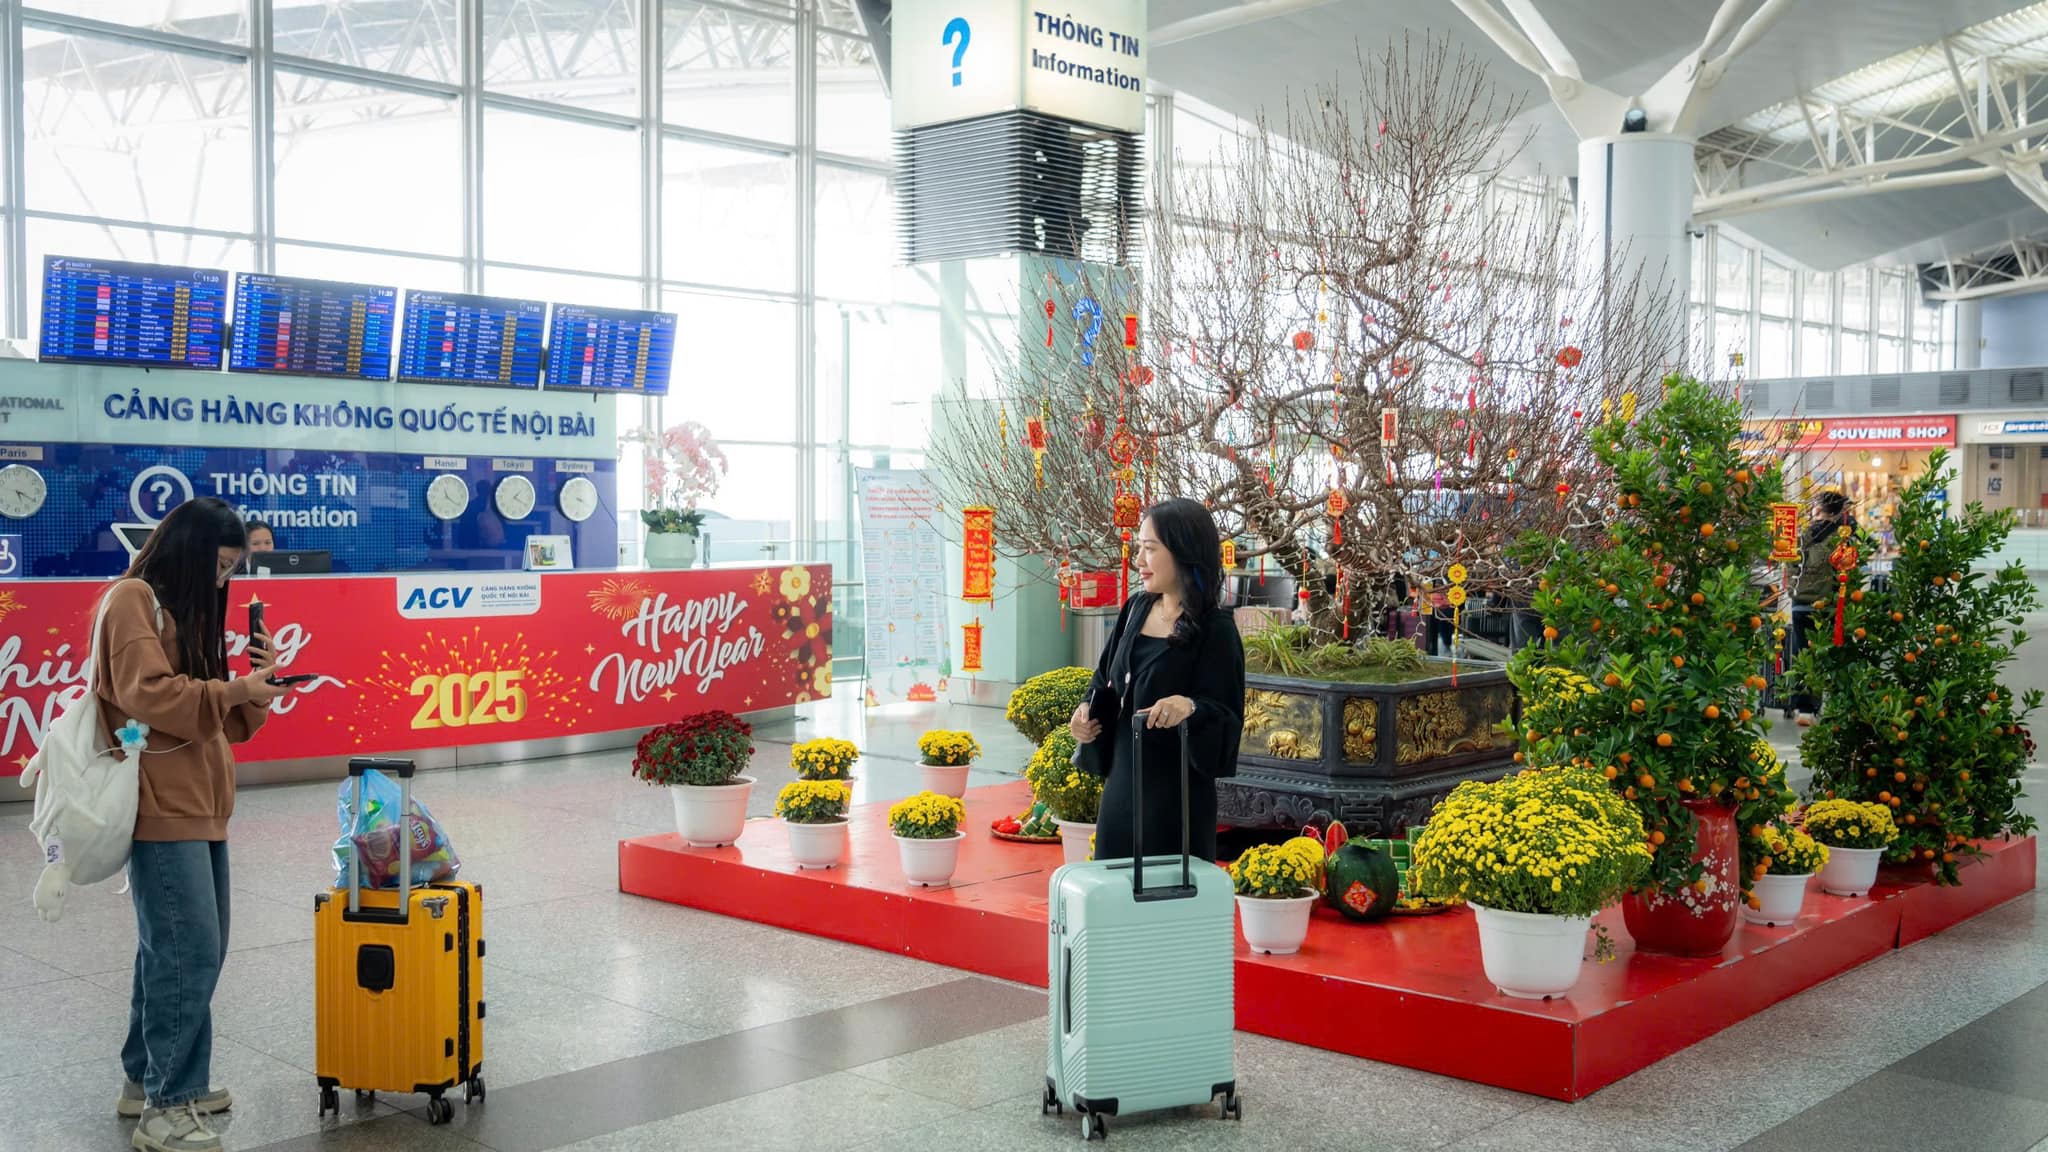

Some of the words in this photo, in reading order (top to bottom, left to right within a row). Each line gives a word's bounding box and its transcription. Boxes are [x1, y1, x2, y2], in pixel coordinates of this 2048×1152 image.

[1034, 11, 1103, 48] THÔNG
[1109, 31, 1139, 58] TIN
[1032, 48, 1140, 92] Information
[104, 388, 194, 421] CẢNG
[201, 396, 287, 426] HÀNG
[295, 400, 393, 430] KHÔNG
[400, 403, 474, 433] QUỐC
[477, 406, 507, 434] TẾ
[511, 410, 553, 440] NỘI
[559, 411, 595, 437] BÀI
[1828, 427, 1903, 439] SOUVENIR
[1907, 426, 1948, 438] SHOP
[0, 448, 28, 458] Paris
[434, 459, 458, 468] Hanoi
[502, 460, 525, 469] Tokyo
[562, 461, 588, 471] Sydney
[210, 468, 307, 496] THÔNG
[315, 474, 357, 497] TIN
[239, 504, 357, 528] formation
[403, 586, 473, 610] ACV
[622, 591, 748, 652] Happy
[589, 648, 685, 705] New
[684, 625, 765, 694] Year
[410, 669, 528, 729] 2025
